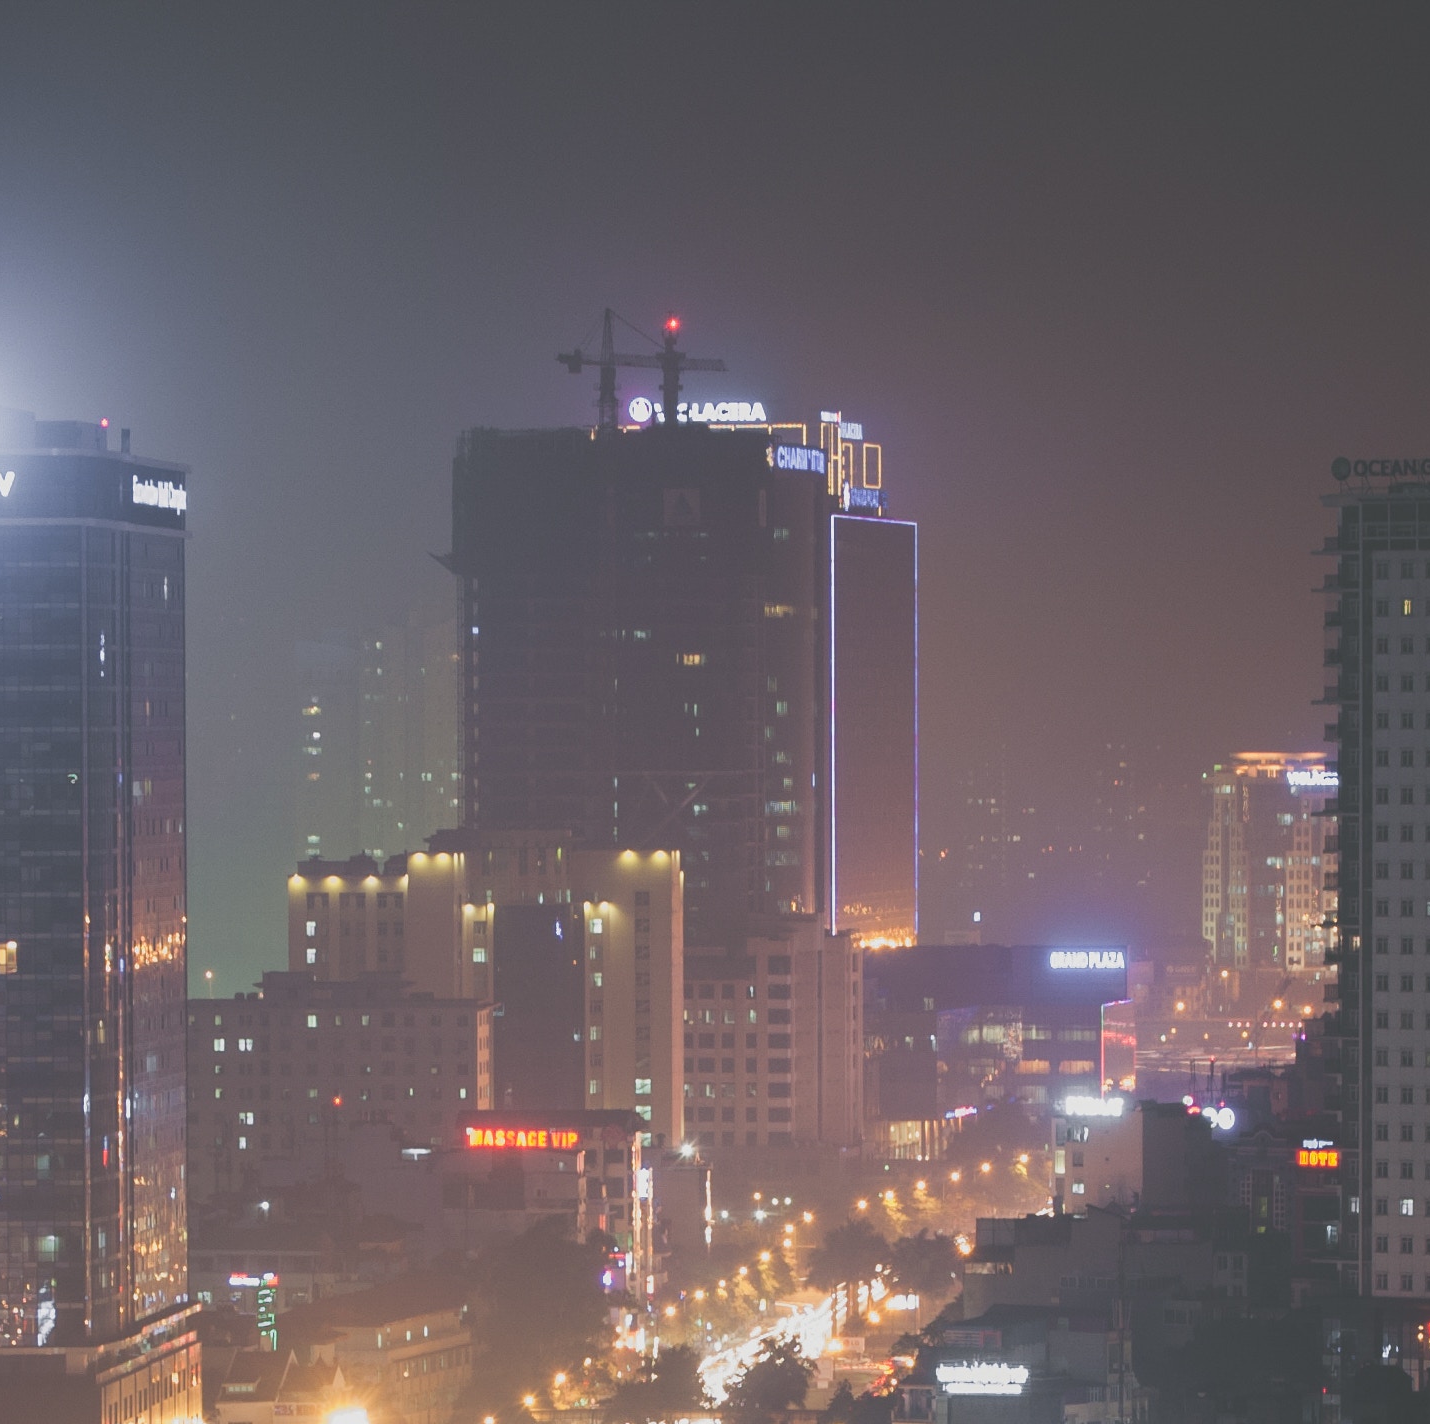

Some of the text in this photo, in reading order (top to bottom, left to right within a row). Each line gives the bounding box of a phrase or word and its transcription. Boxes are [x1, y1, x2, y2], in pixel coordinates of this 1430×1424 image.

[1353, 459, 1419, 477] OCEAN
[1089, 951, 1125, 969] PLAZA
[469, 1129, 578, 1149] MASSAGE VIP
